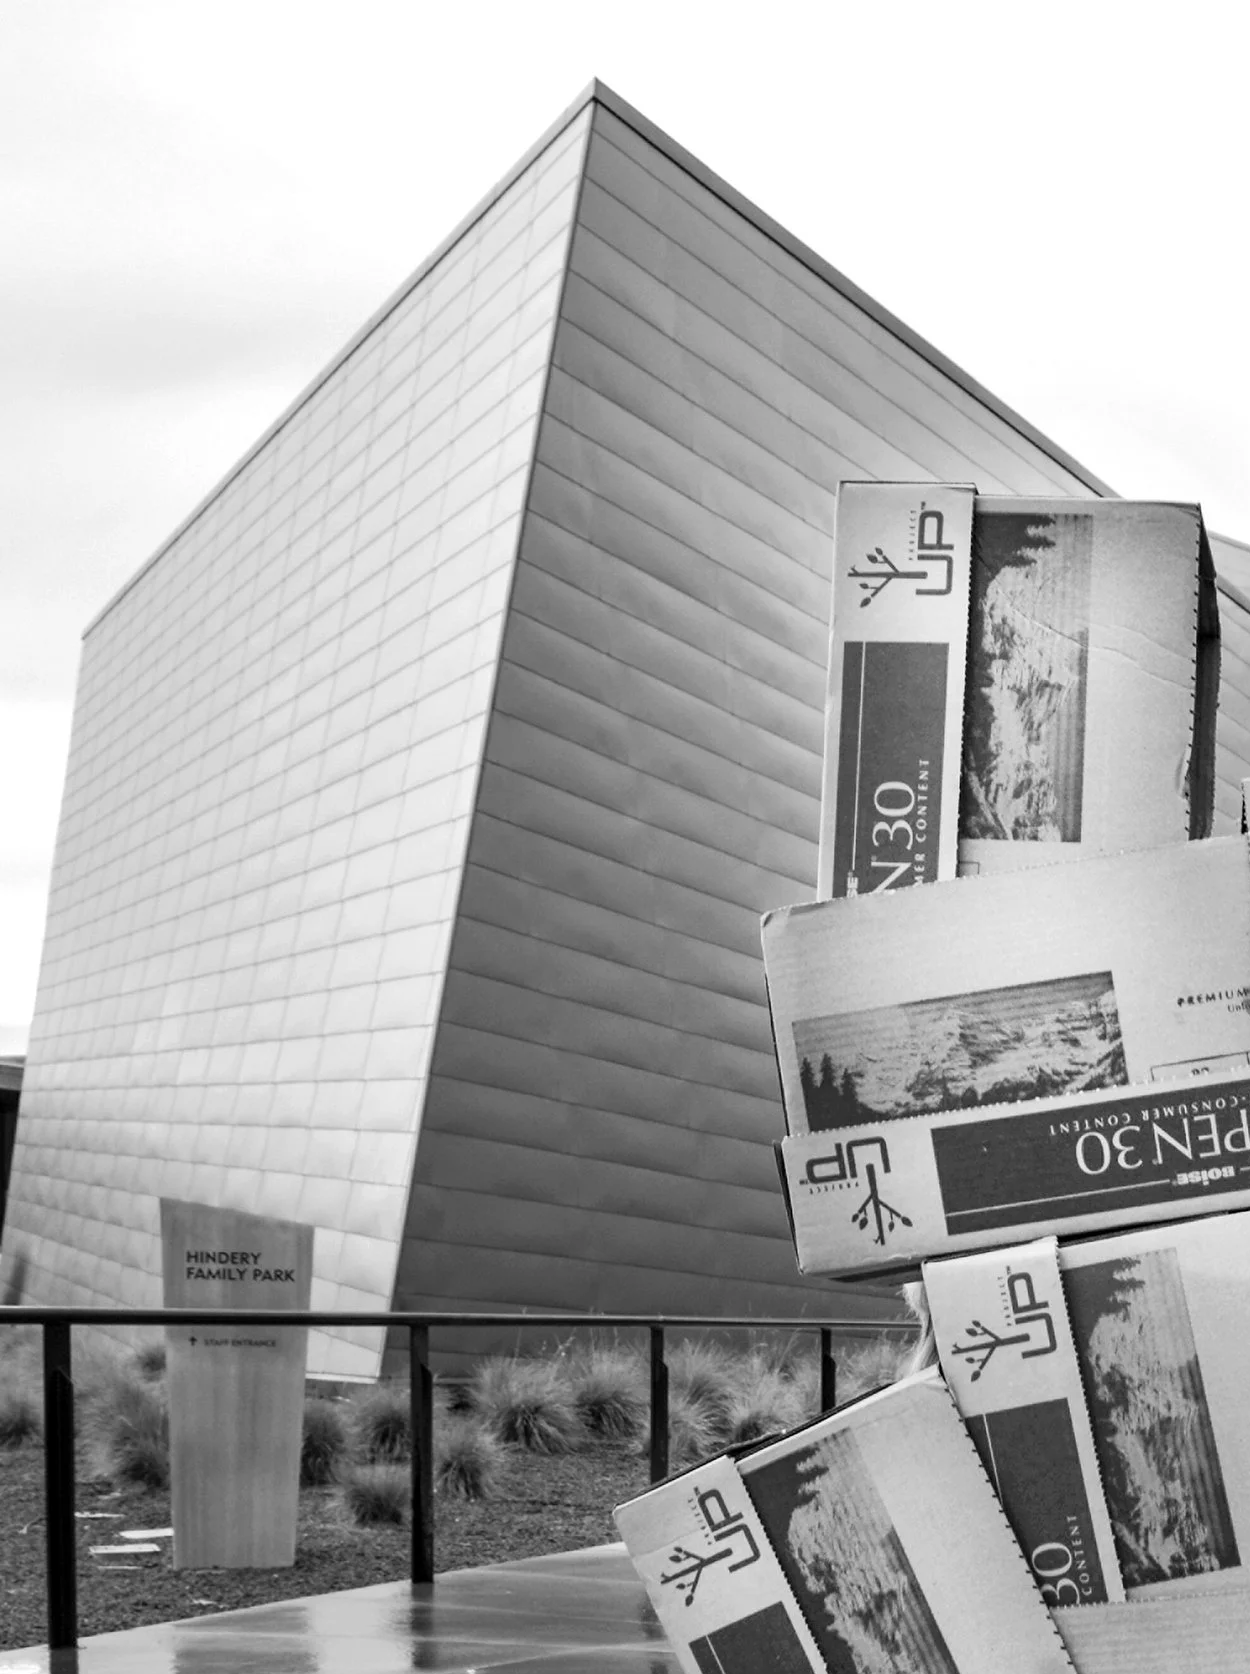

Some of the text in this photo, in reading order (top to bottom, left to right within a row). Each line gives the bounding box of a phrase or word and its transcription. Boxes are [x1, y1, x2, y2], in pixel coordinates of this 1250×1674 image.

[915, 510, 955, 596] UP
[872, 781, 915, 851] 30
[915, 759, 930, 844] CONTENT
[1177, 986, 1249, 1007] PREMIUM
[1049, 1112, 1131, 1136] CONTENT
[1075, 1125, 1143, 1175] 30
[805, 1136, 892, 1185] UP
[186, 1250, 262, 1265] HINDERY
[186, 1266, 295, 1282] FAMILY PARK
[1007, 1271, 1058, 1360] UP
[697, 1488, 761, 1574] UP
[1066, 1515, 1093, 1597] CONTENT
[1031, 1541, 1081, 1605] 30
